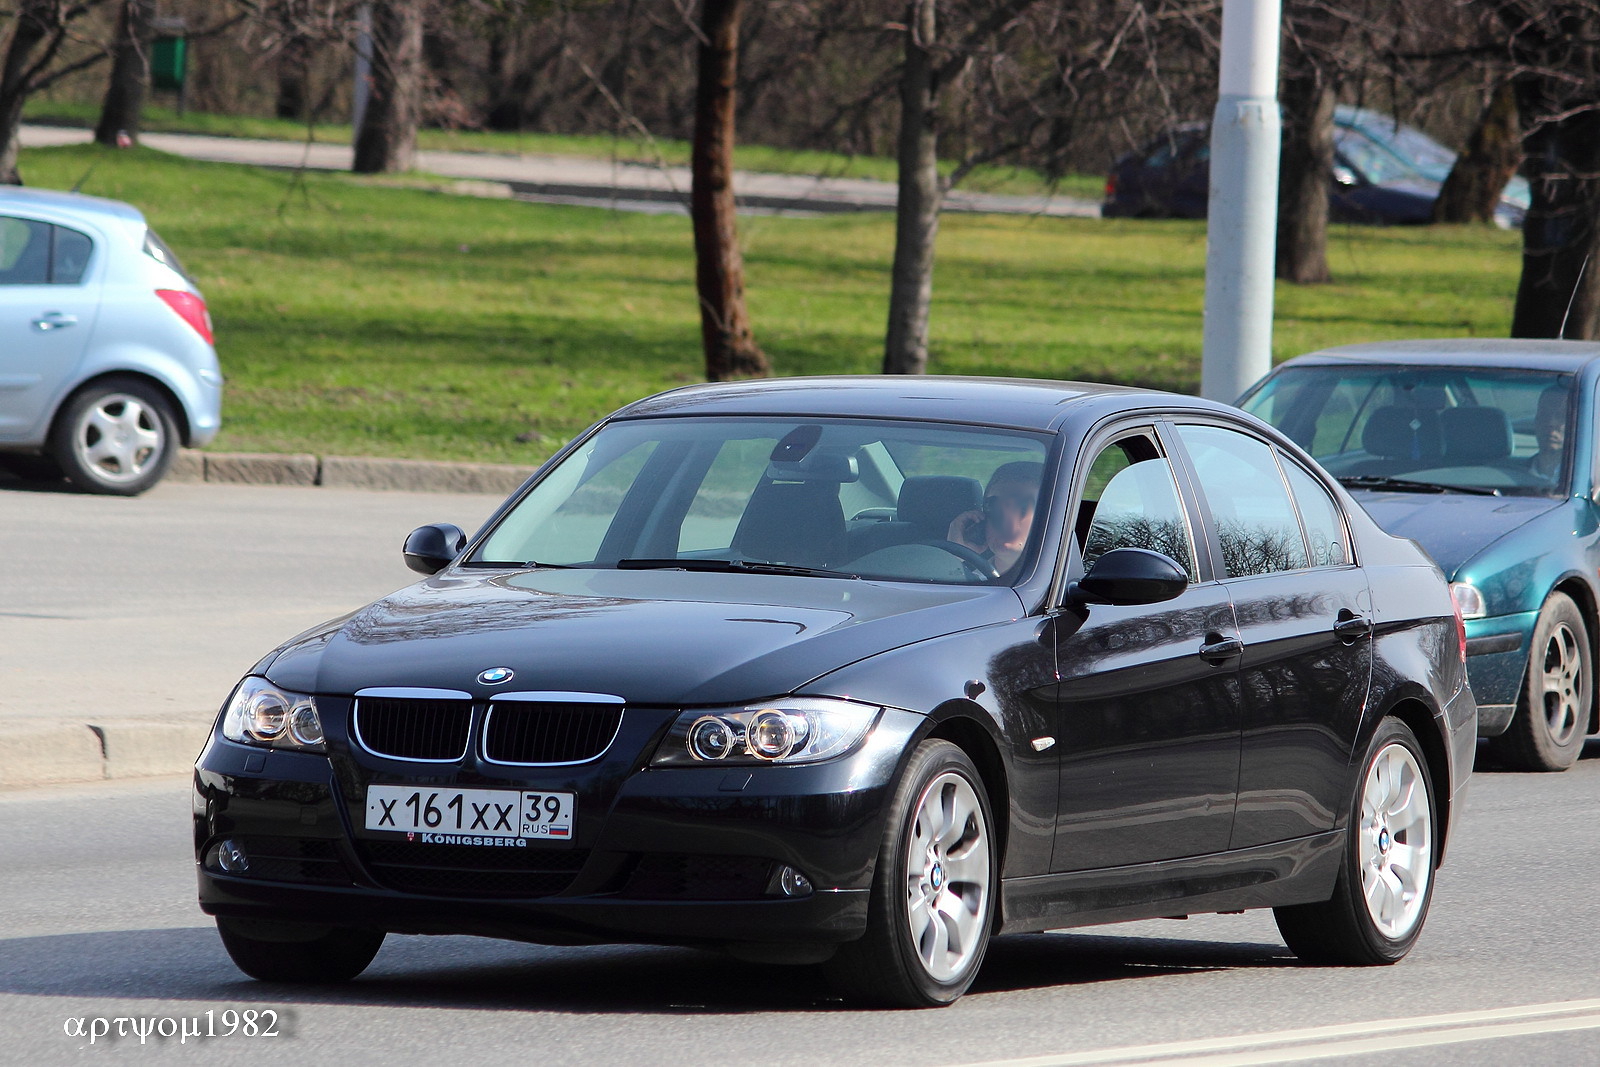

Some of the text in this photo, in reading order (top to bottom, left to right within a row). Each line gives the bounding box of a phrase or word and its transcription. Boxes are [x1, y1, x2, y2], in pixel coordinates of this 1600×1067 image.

[525, 794, 561, 823] 39
[522, 823, 549, 834] RUS
[421, 832, 527, 848] KÖNIGSBERG
